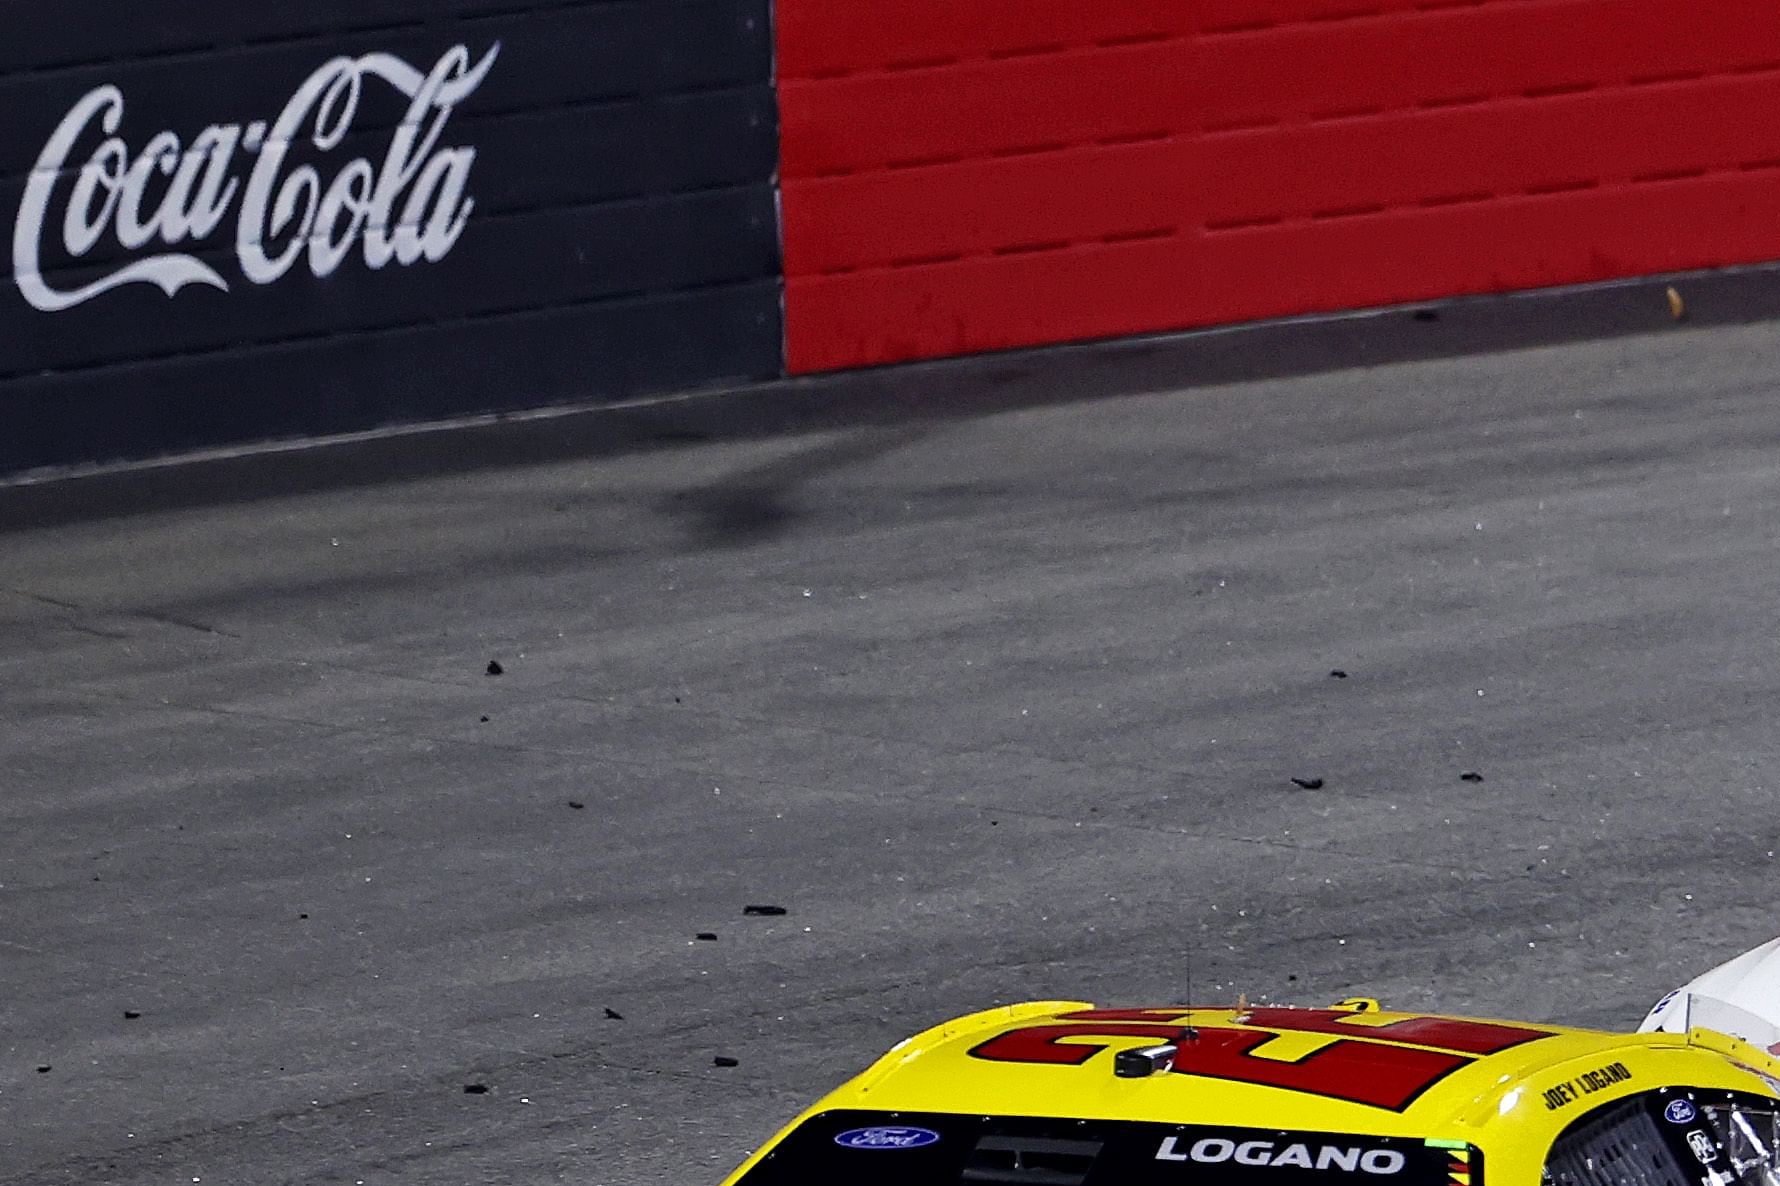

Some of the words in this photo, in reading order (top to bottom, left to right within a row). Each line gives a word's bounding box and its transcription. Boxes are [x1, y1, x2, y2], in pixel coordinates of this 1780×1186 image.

[1542, 1080, 1579, 1111] JOEY
[1575, 1062, 1632, 1095] LOGANO
[851, 1128, 921, 1146] Ford
[1155, 1136, 1403, 1175] LOGANO
